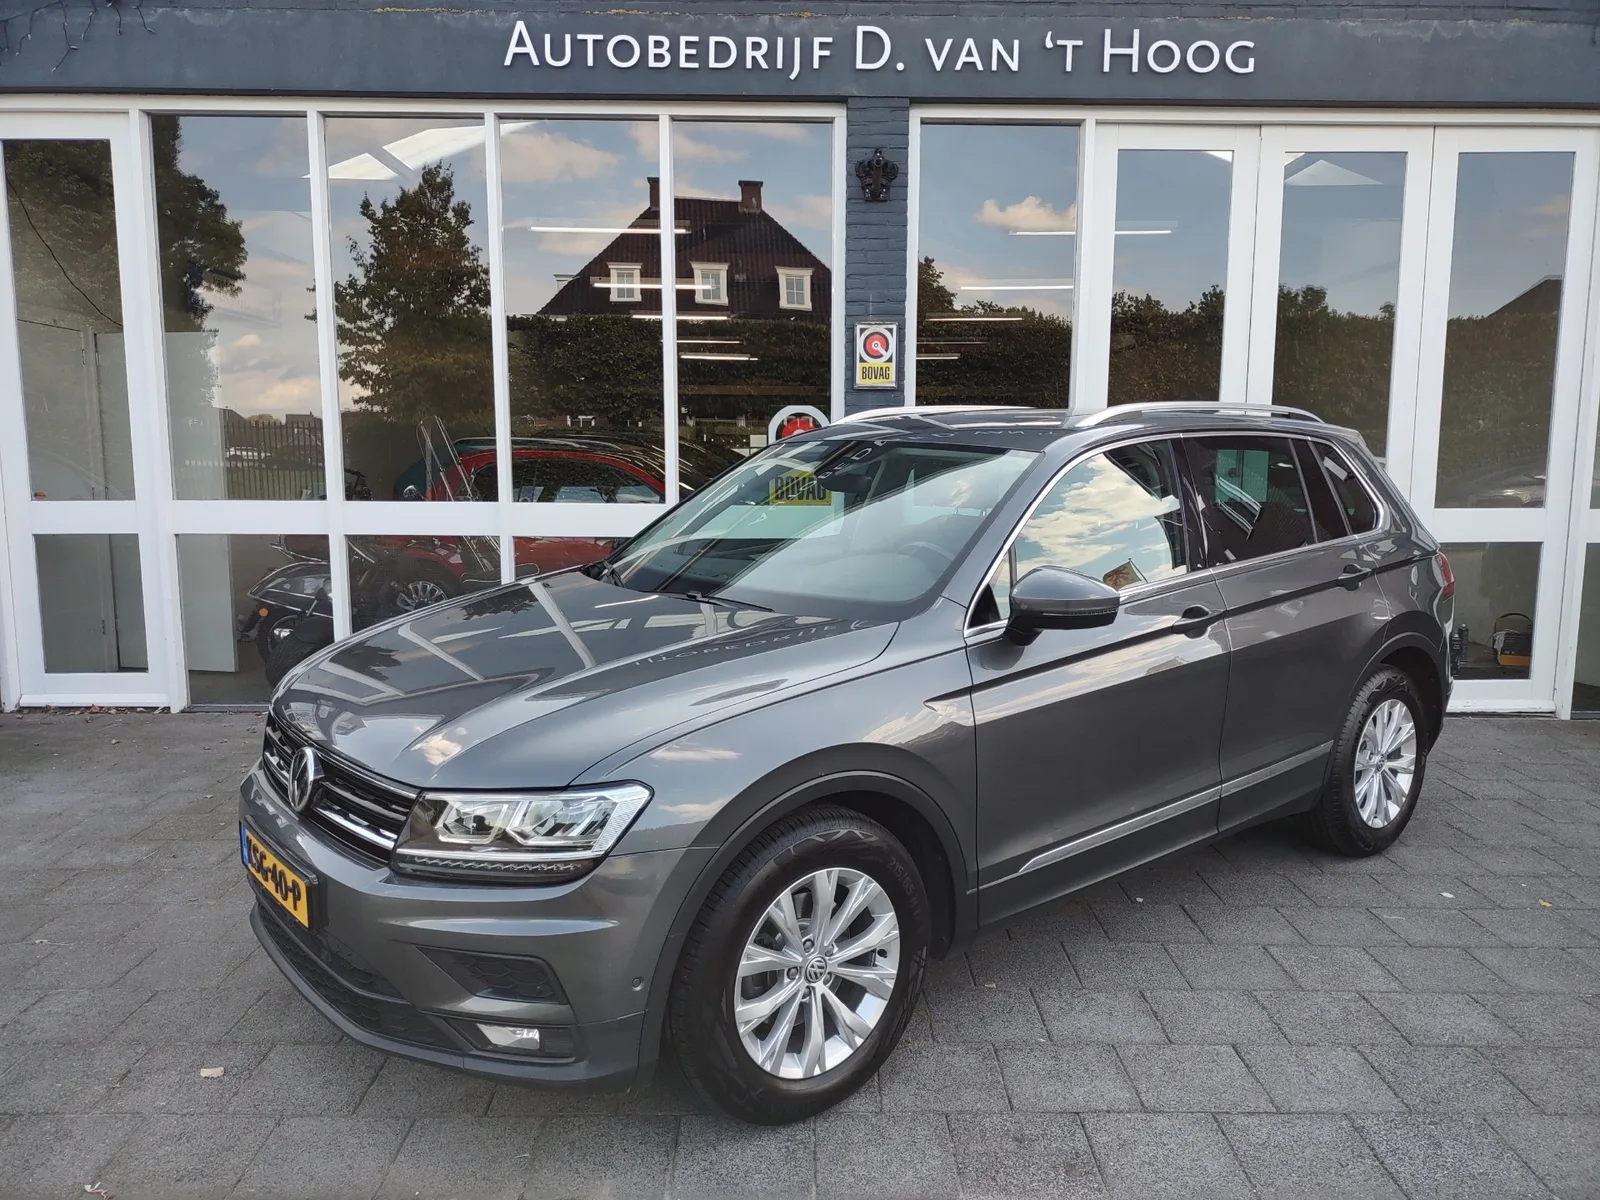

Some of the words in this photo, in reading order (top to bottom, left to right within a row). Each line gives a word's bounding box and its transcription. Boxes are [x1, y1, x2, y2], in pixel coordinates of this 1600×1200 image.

[503, 20, 834, 81] AUTOBEDRIJF
[855, 25, 905, 72] D.
[924, 37, 1020, 72] VAN
[1102, 28, 1256, 74] HOOG
[861, 366, 891, 380] BOVAG
[774, 475, 827, 501] BOVAG
